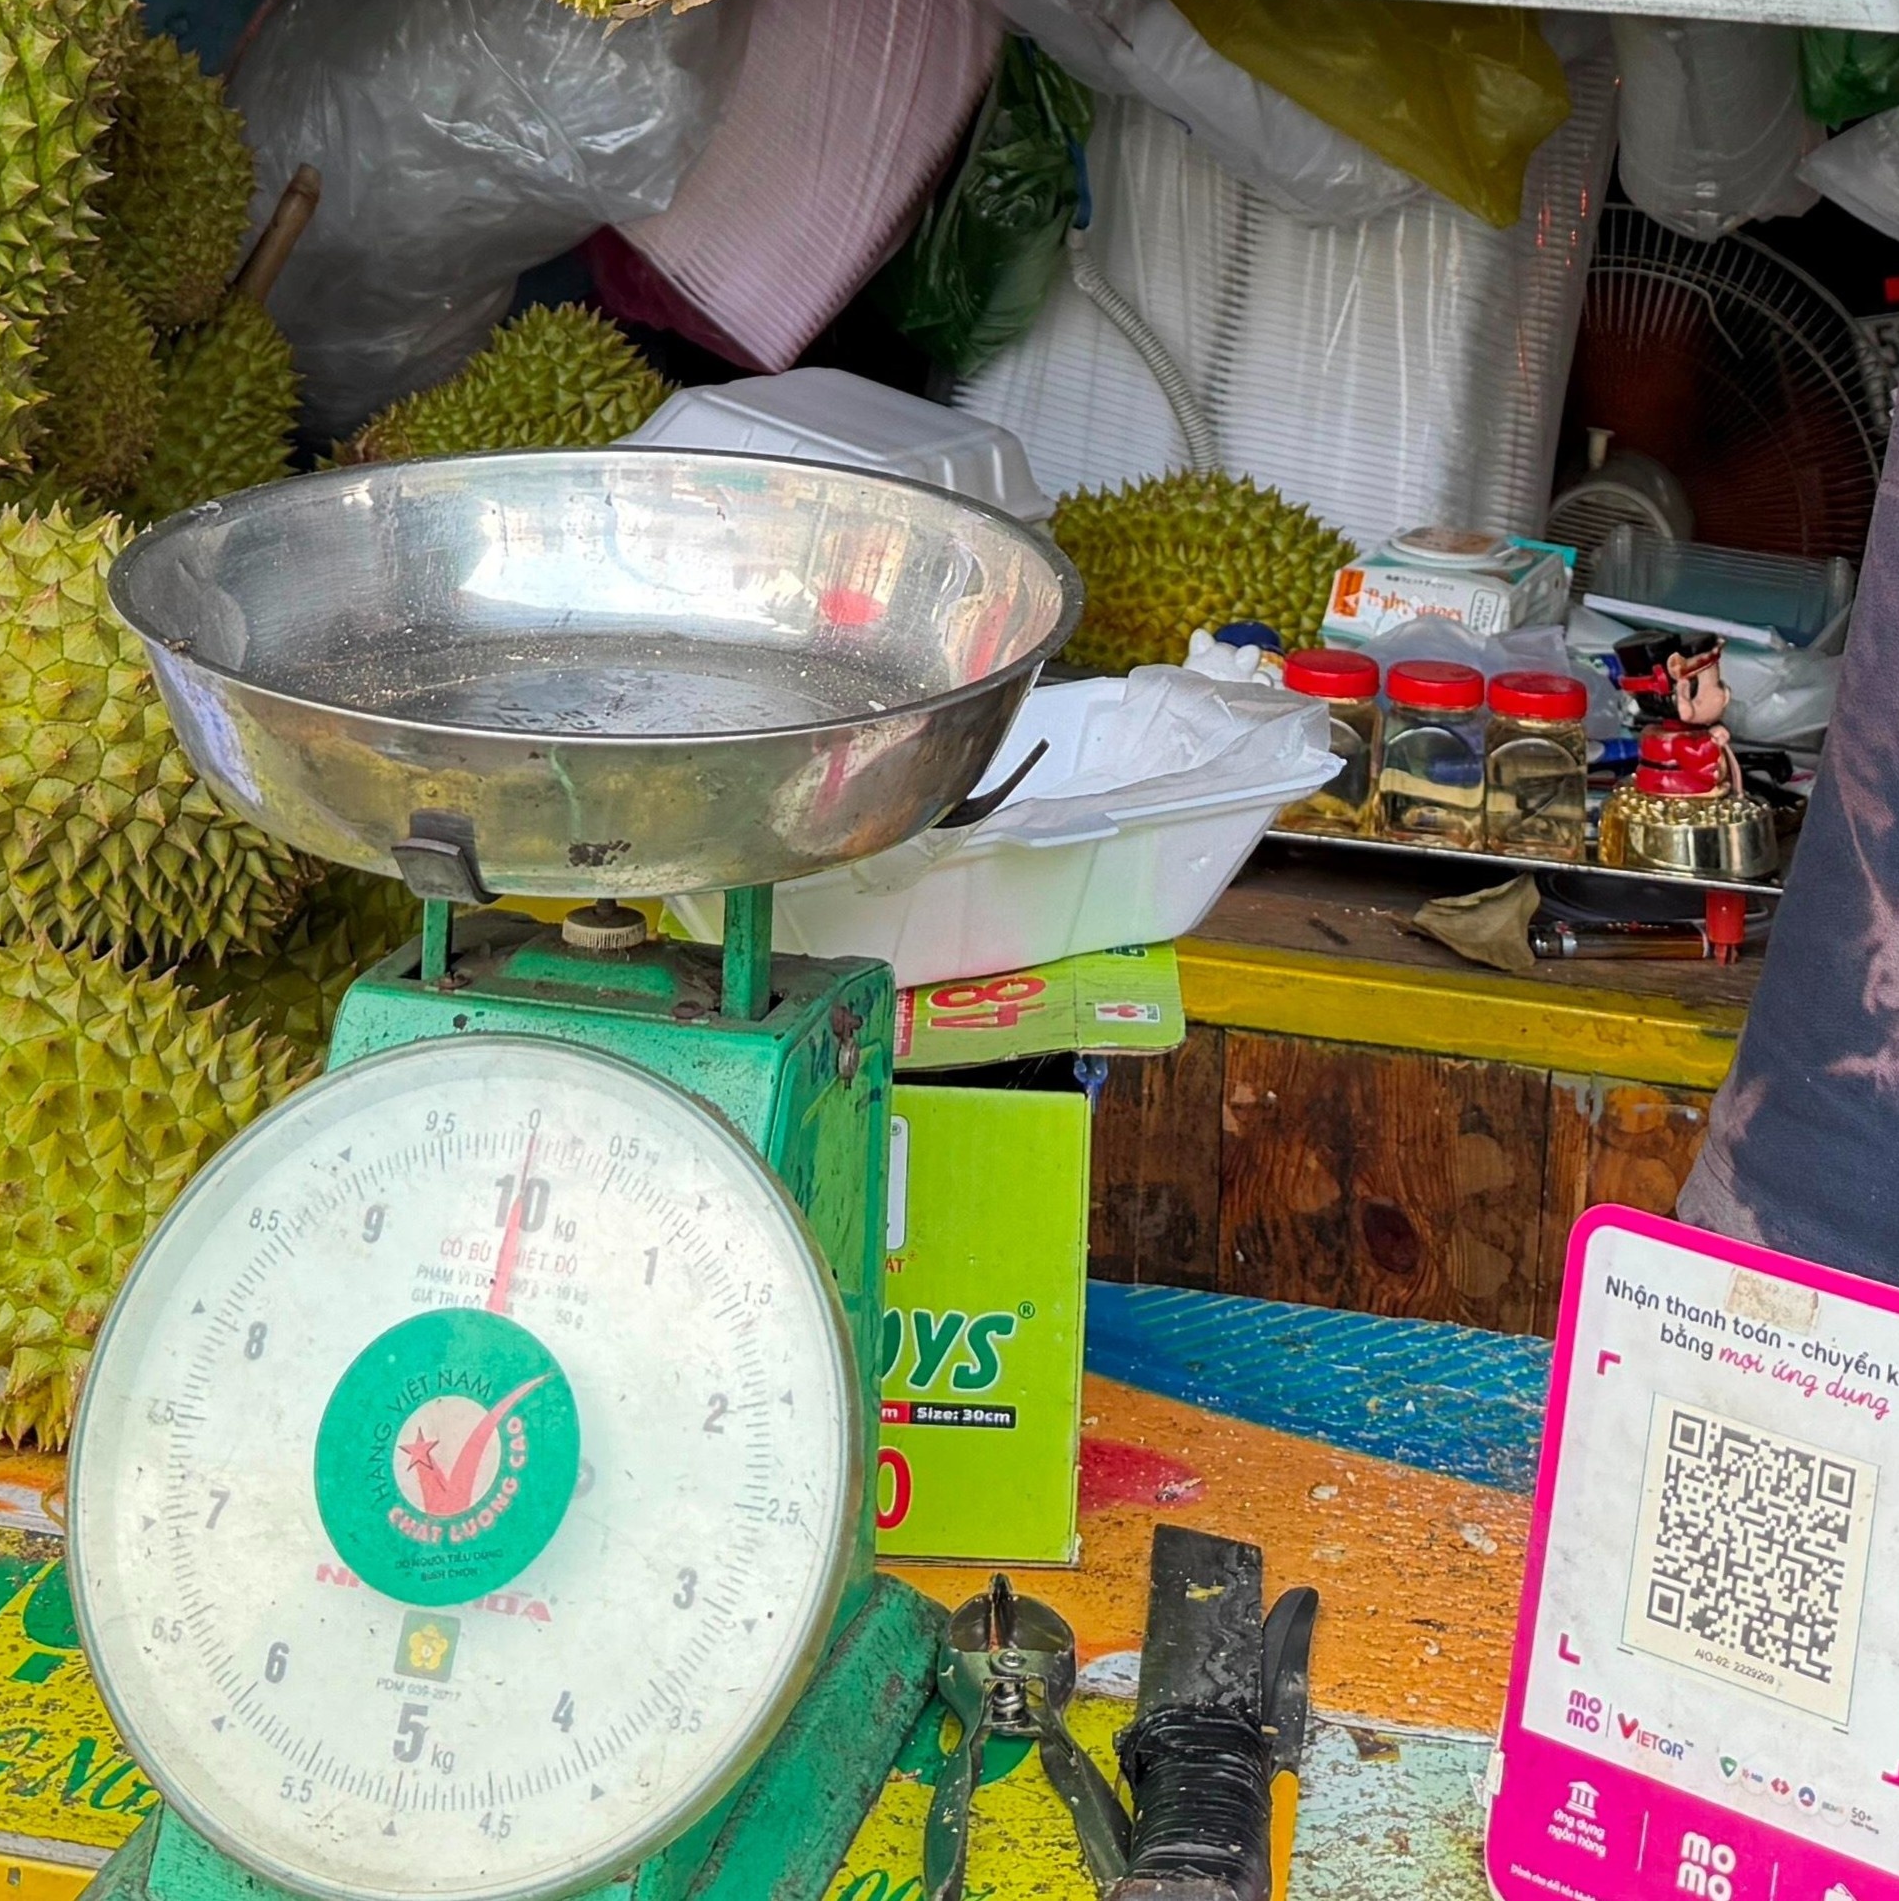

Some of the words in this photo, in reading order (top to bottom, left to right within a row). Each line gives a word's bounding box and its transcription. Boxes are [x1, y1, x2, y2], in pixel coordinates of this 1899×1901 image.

[608, 1134, 641, 1161] 0,5
[248, 1206, 280, 1233] 8,5
[362, 1203, 387, 1244] 9
[492, 1174, 552, 1234] 10
[554, 1214, 579, 1243] kg
[643, 1246, 659, 1286] 1
[742, 1280, 774, 1306] 1,5
[244, 1320, 268, 1361] 8
[1604, 1275, 1661, 1310] Nhận
[1665, 1294, 1728, 1332] thanh
[1732, 1315, 1782, 1350] toán
[1801, 1339, 1882, 1381] chuyển
[438, 1369, 493, 1400] NAM
[1660, 1321, 1715, 1362] bằng
[1717, 1345, 1766, 1376] mọi
[1770, 1357, 1821, 1399] ứng
[1824, 1373, 1892, 1422] dụng
[702, 1392, 729, 1435] 2
[915, 1405, 960, 1421] Size:
[961, 1408, 1012, 1425] 30cm
[205, 1489, 232, 1531] 7
[766, 1498, 801, 1527] 2,5
[672, 1566, 699, 1611] 3
[150, 1616, 184, 1645] 6,5
[264, 1641, 291, 1685] 6
[551, 1689, 575, 1734] 4
[667, 1705, 703, 1734] 3,5
[392, 1701, 429, 1763] 5
[430, 1743, 456, 1776] kg
[279, 1774, 315, 1805] 5,5
[477, 1809, 513, 1840] 4,5
